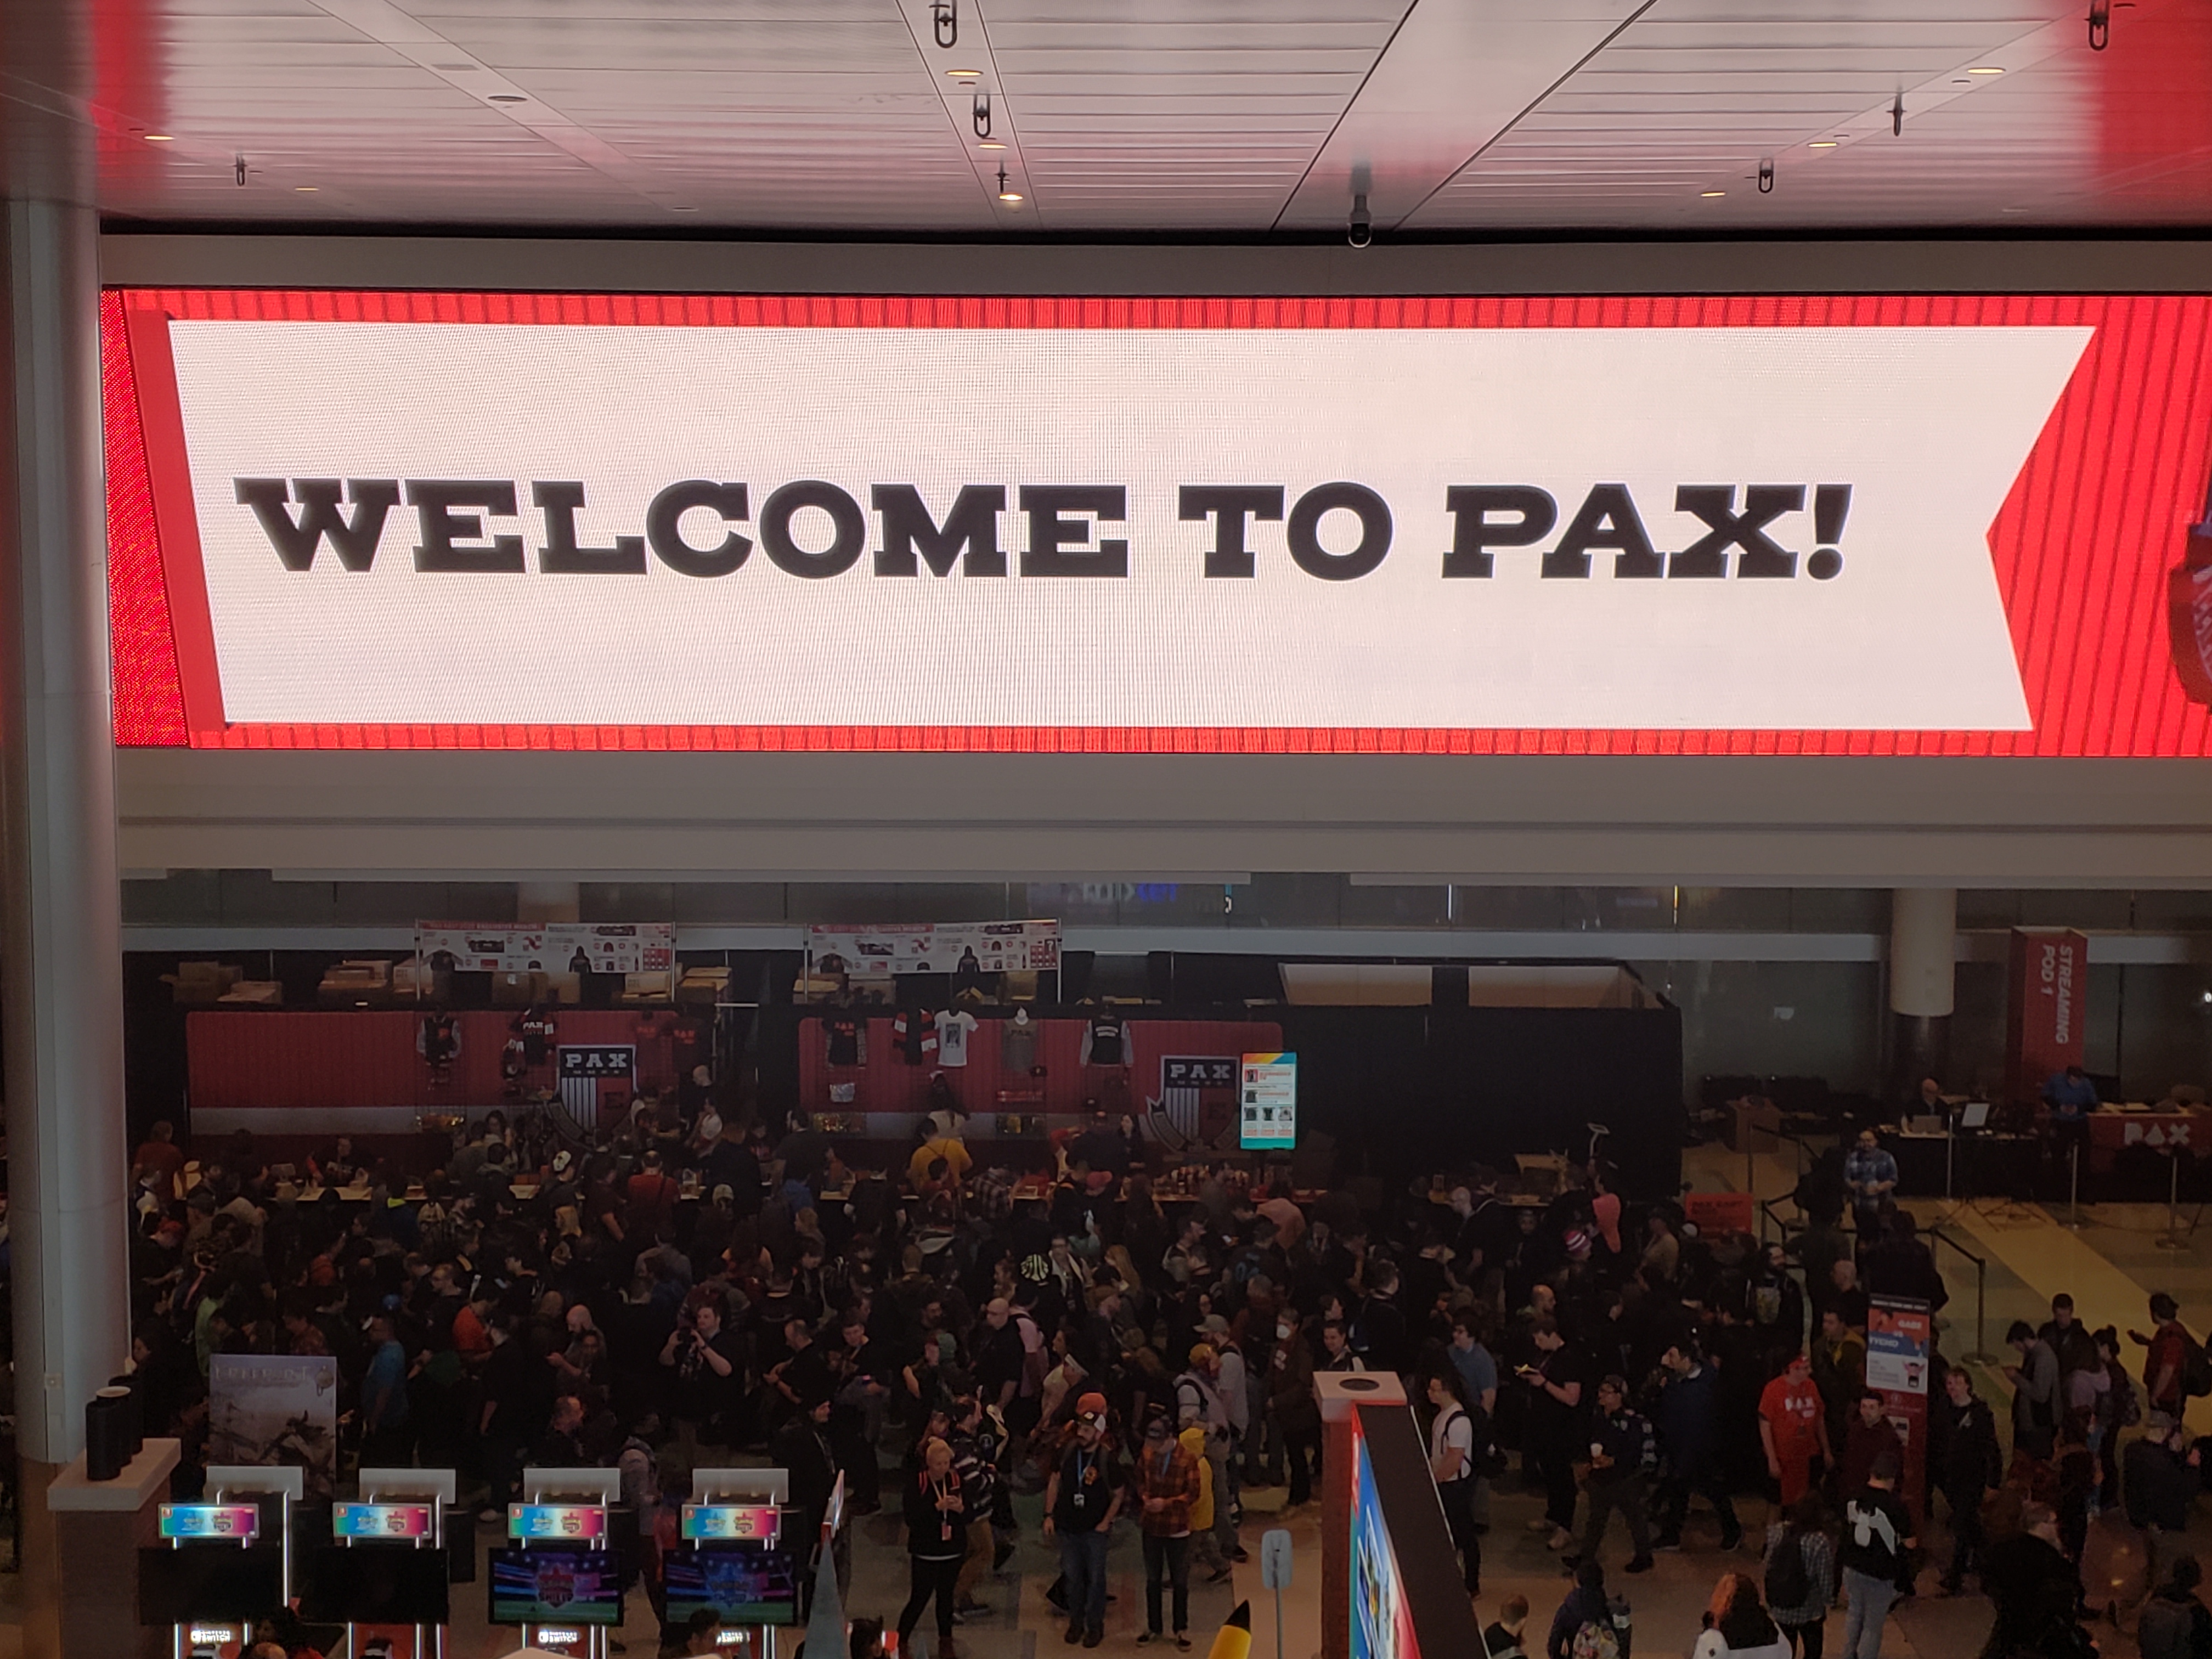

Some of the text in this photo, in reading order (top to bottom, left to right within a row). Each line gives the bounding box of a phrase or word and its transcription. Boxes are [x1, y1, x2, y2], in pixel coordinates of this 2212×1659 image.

[236, 479, 1851, 580] WELCOME TO PAX!
[2040, 944, 2056, 996] POD 1
[2056, 944, 2073, 1045] STREAMING
[566, 1053, 627, 1068] PAX
[1170, 1064, 1231, 1079] PAX
[2124, 1122, 2191, 1147] PAX
